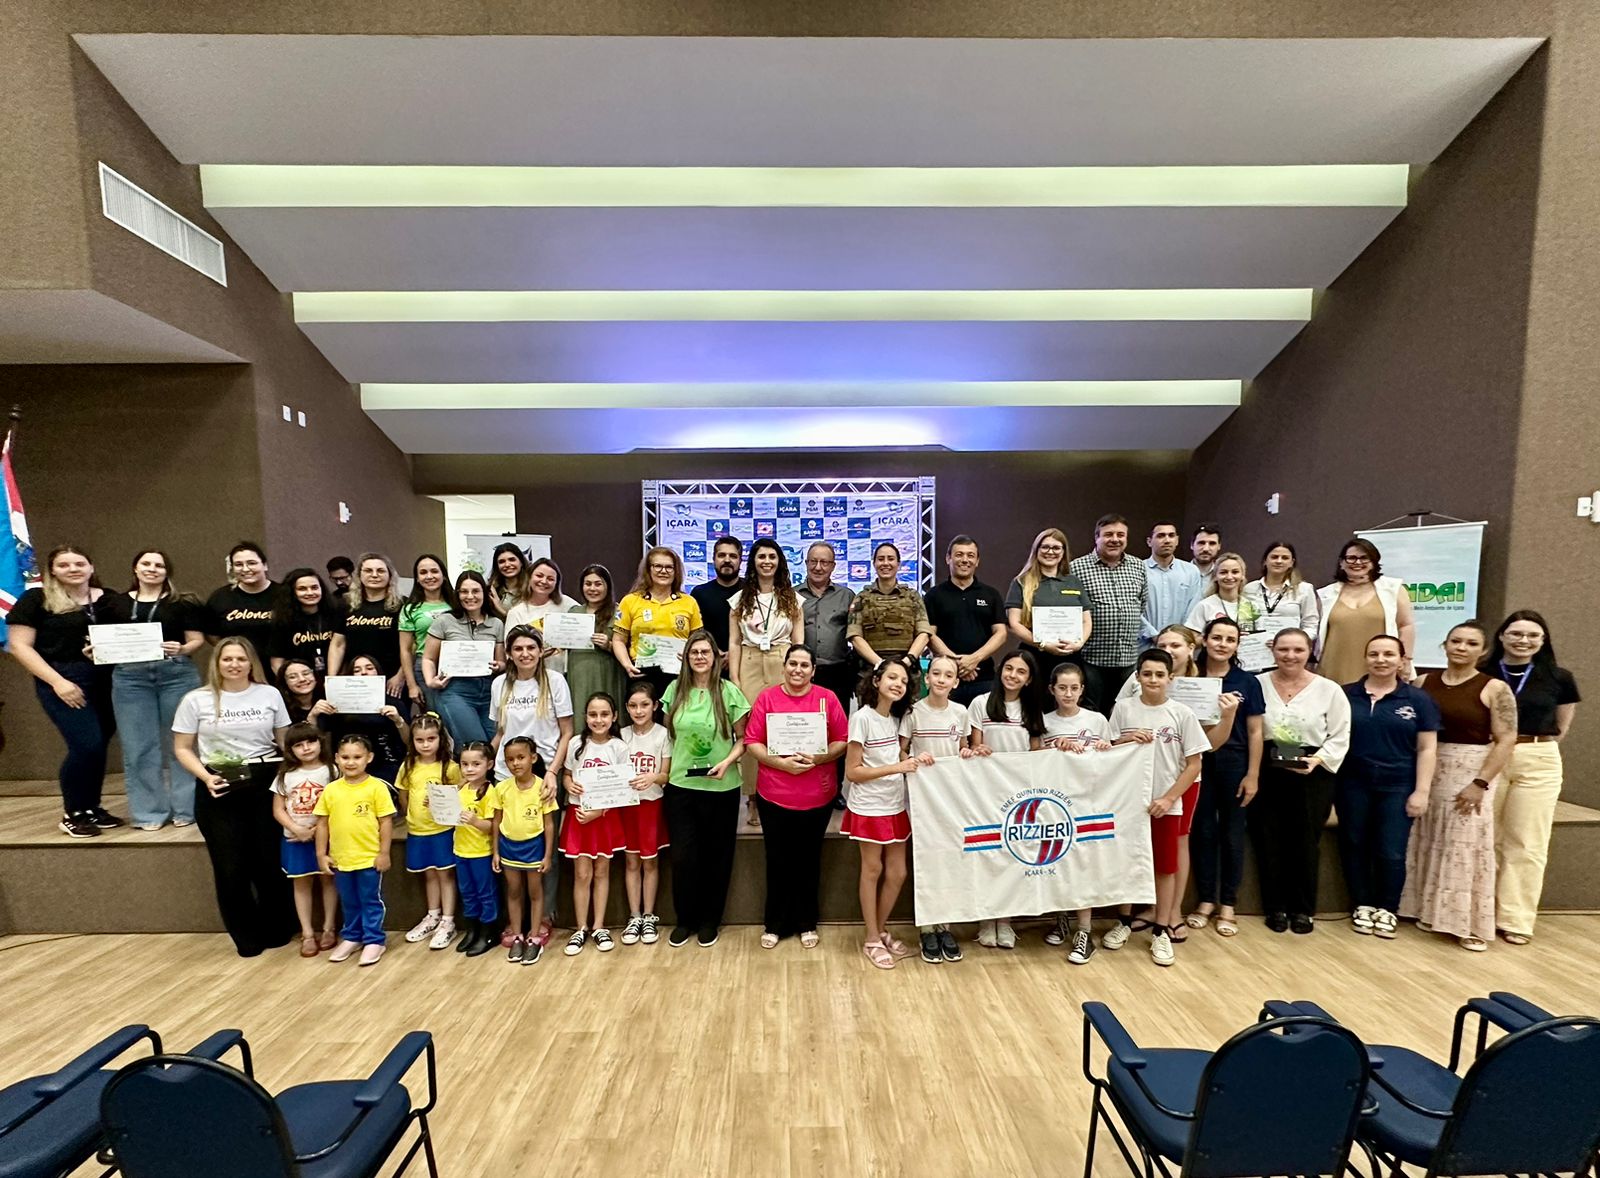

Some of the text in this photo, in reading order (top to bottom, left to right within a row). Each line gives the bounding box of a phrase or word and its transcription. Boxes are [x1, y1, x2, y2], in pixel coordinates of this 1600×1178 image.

[667, 519, 699, 529] IÇARA
[878, 517, 910, 525] IÇARA
[346, 615, 393, 627] Colonetti
[1000, 788, 1073, 813] EMEF QUINTINO RIZZIERI
[1008, 822, 1070, 841] RIZZIERI
